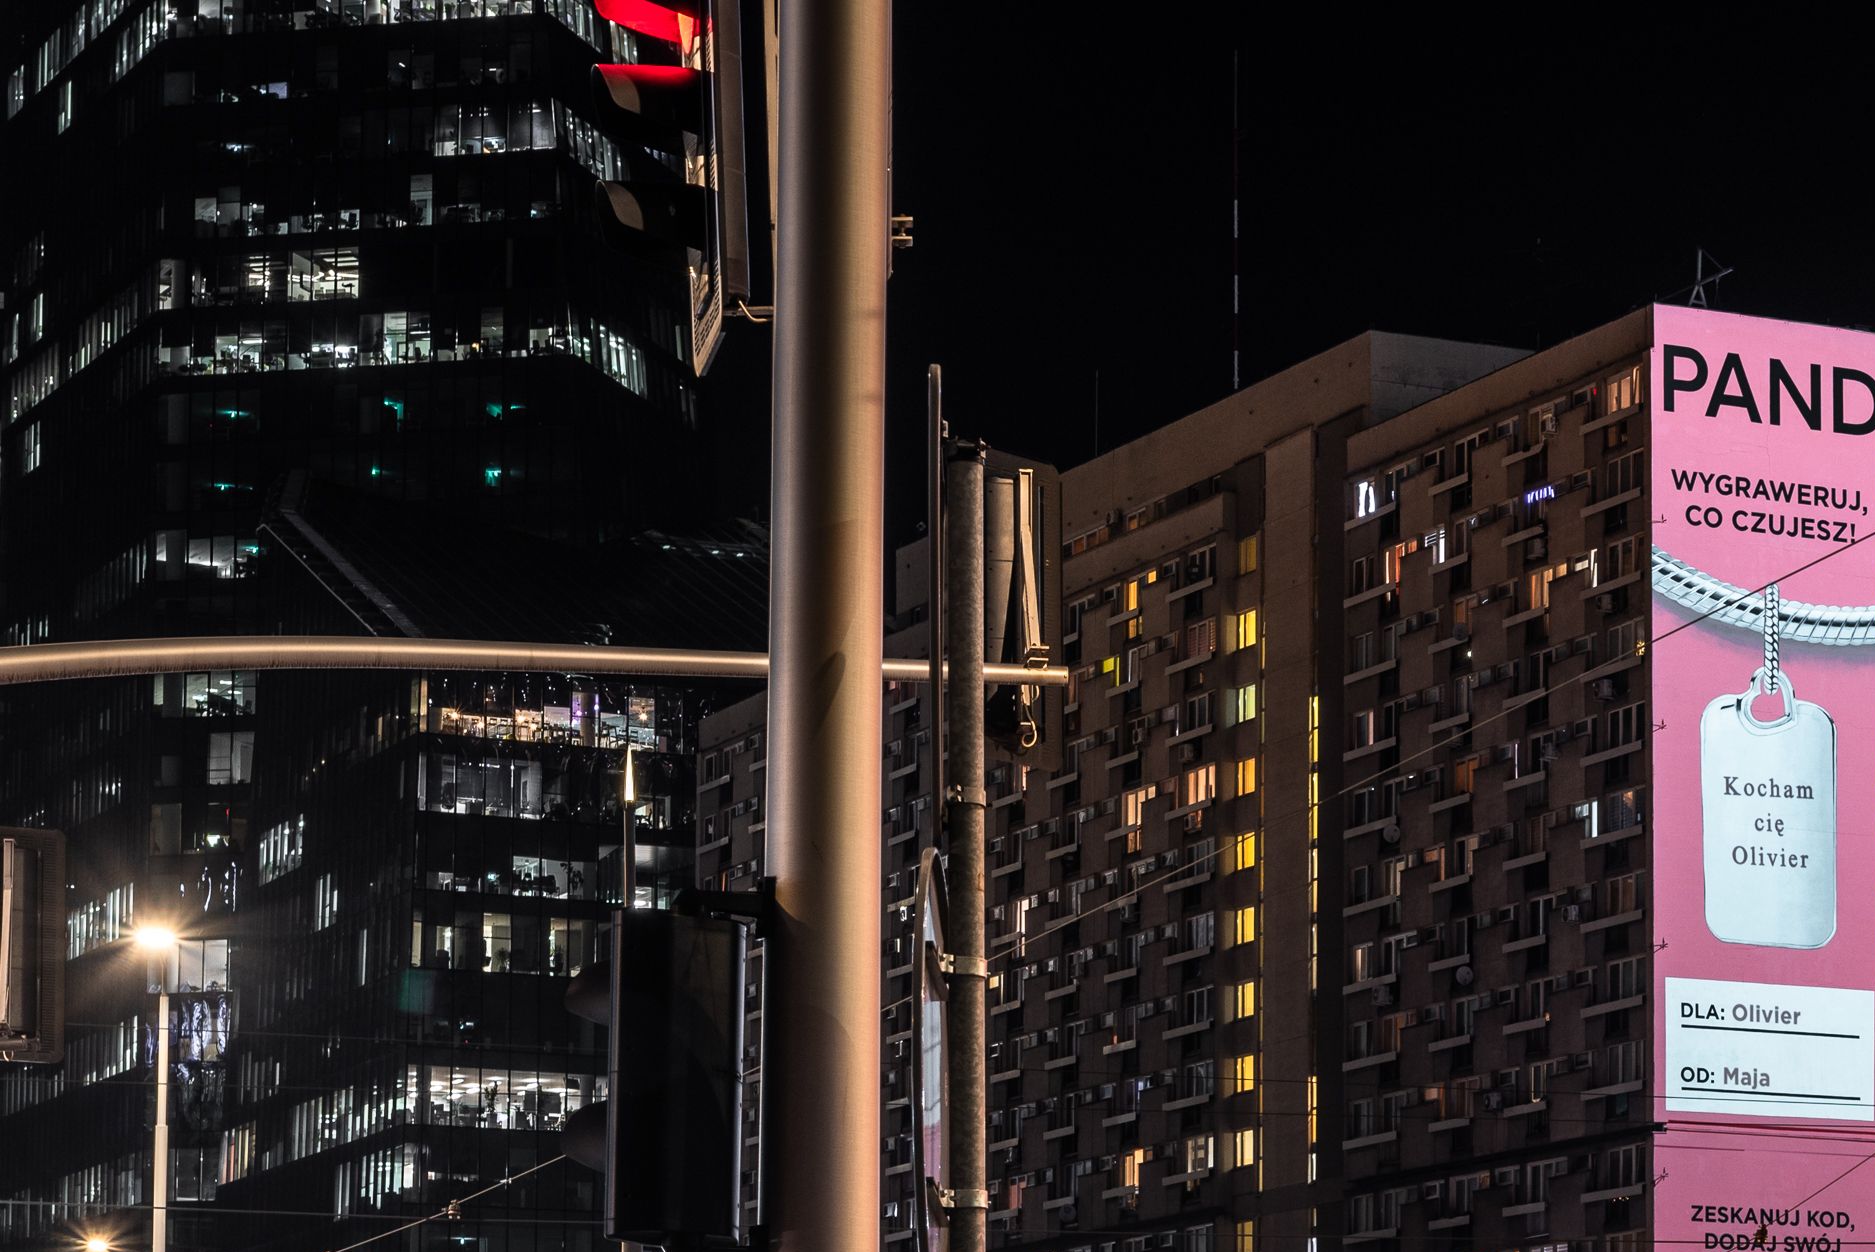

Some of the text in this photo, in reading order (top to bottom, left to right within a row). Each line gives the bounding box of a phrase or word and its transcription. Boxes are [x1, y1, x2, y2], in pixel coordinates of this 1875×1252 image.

[1671, 468, 1869, 517] WYGRAWERUJ,
[1685, 504, 1857, 544] CO CZUJESZ!
[1723, 775, 1815, 801] Kocham
[1754, 812, 1786, 835] cię
[1731, 844, 1810, 869] Olivier
[1680, 1001, 1802, 1026] DLA: Olivier
[1680, 1065, 1772, 1090] OD: Maja
[1690, 1205, 1857, 1233] ZESKANUJ KOD,
